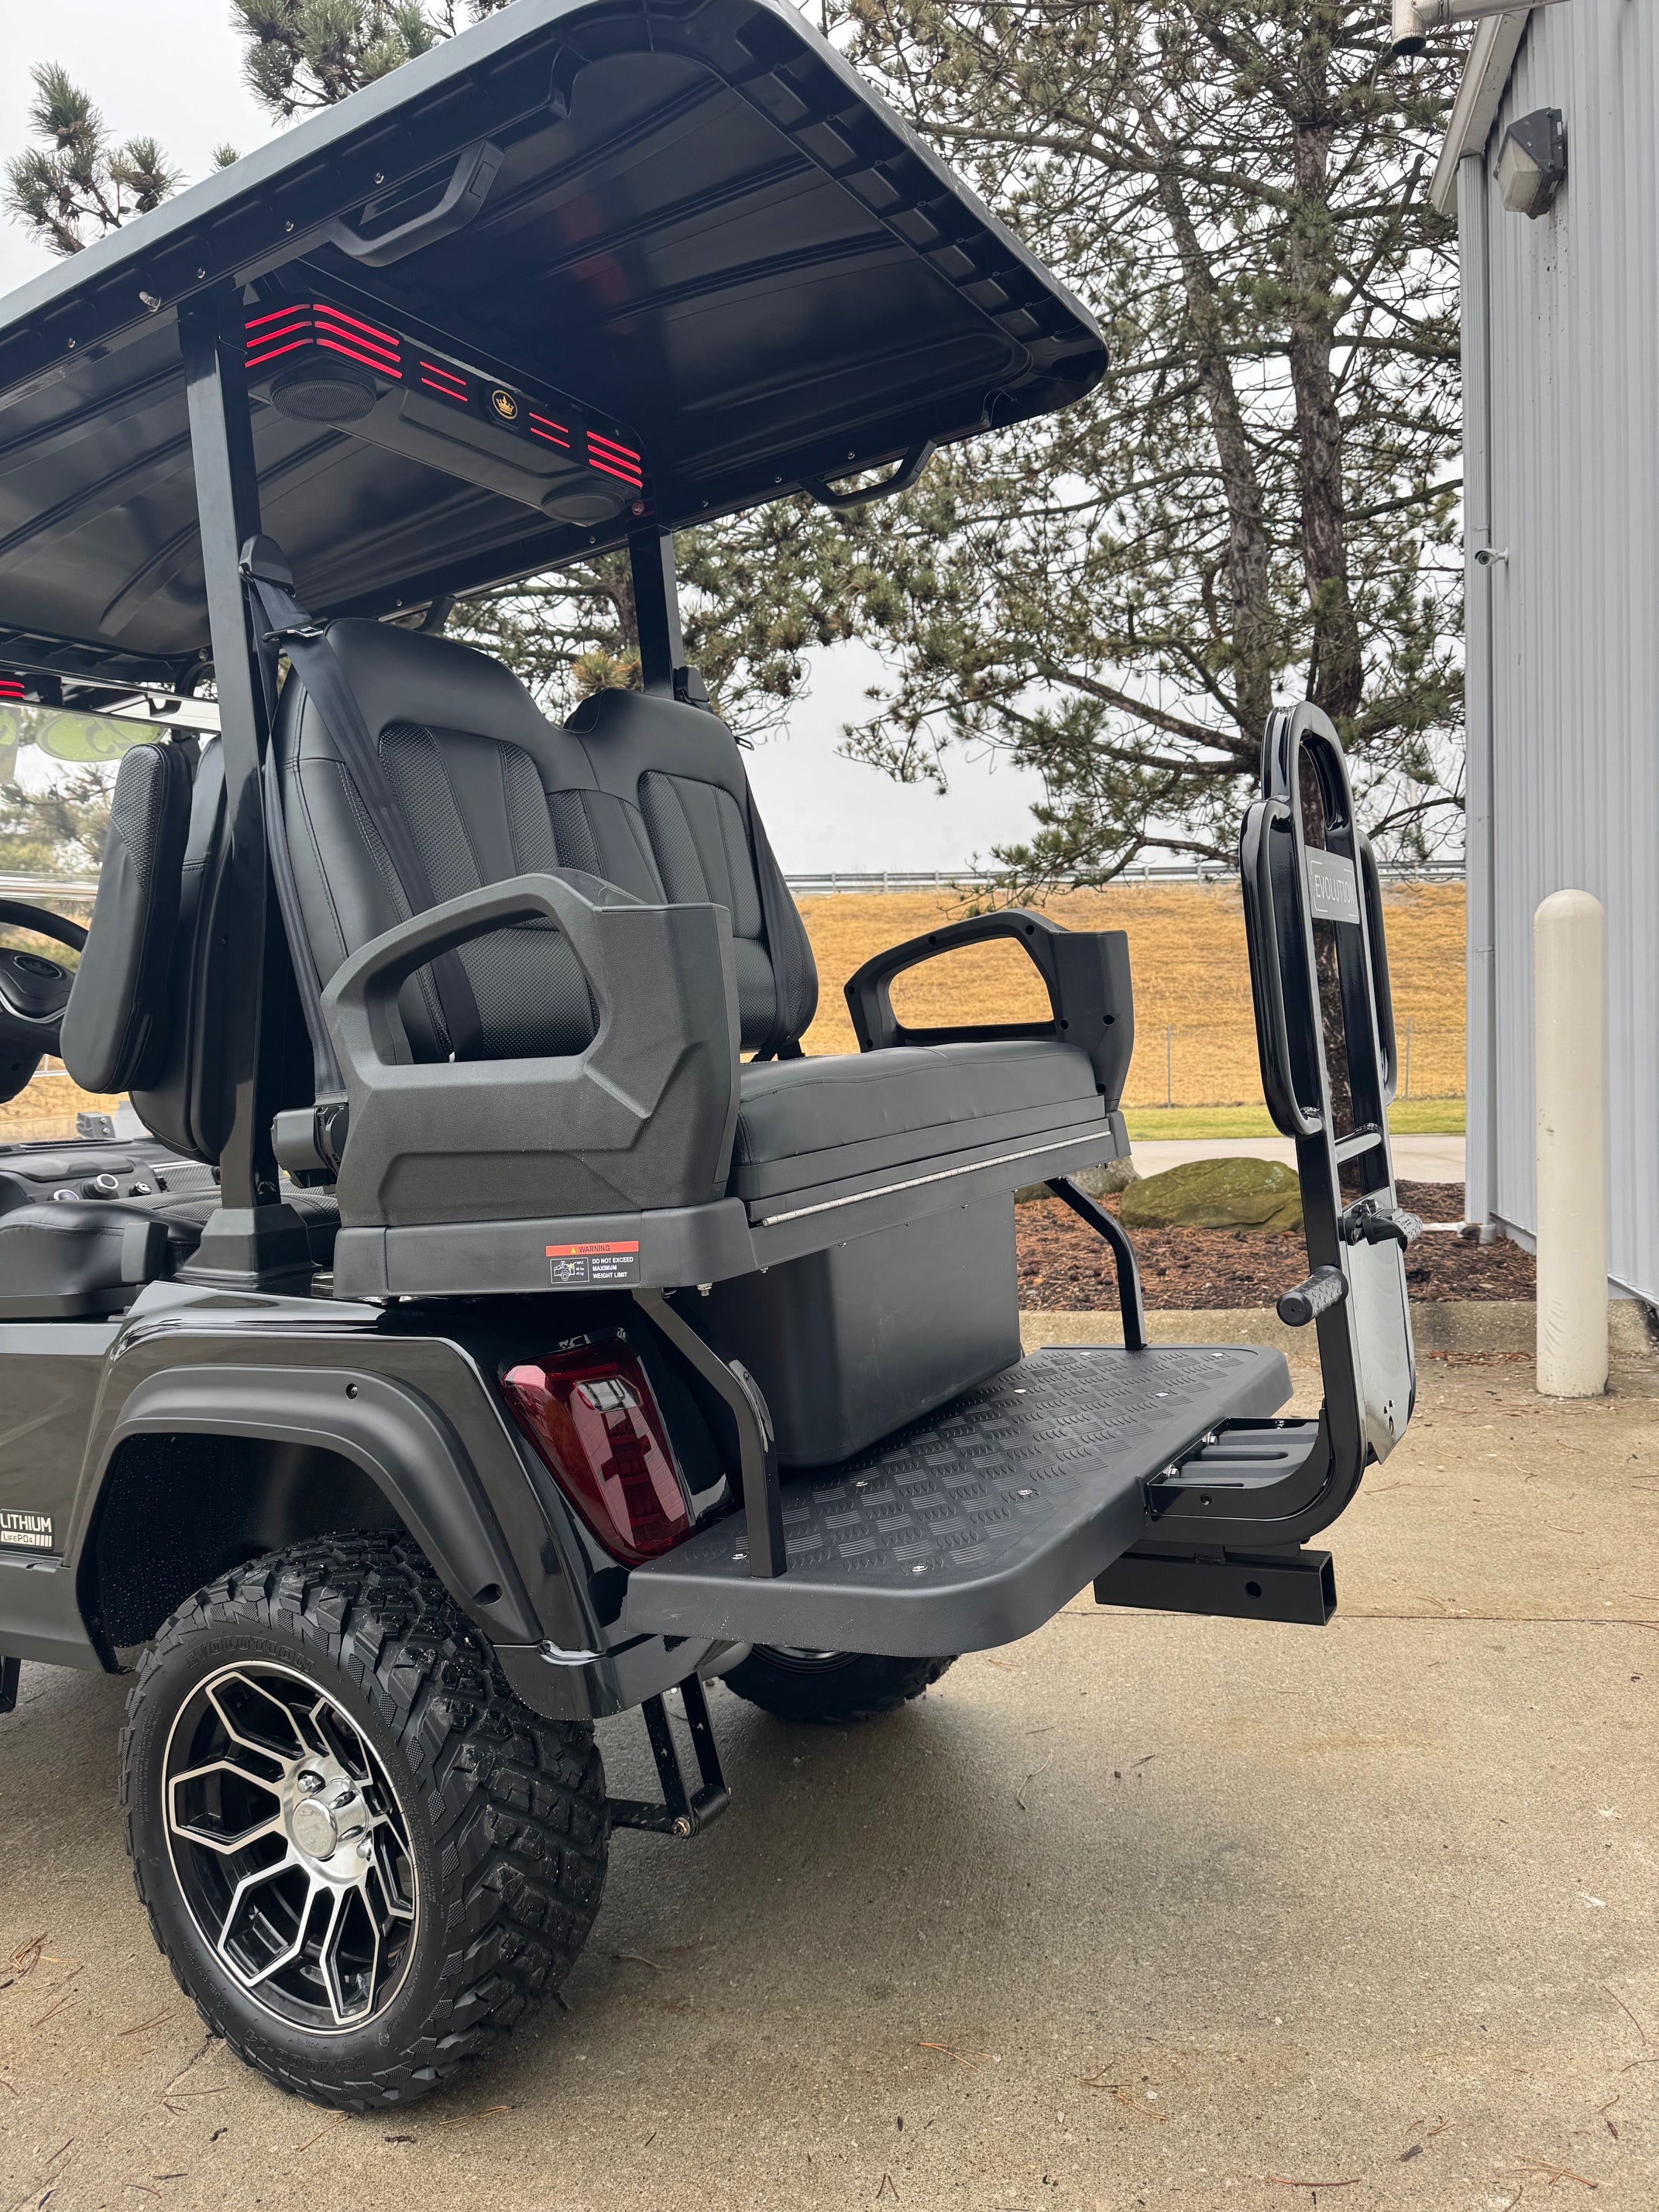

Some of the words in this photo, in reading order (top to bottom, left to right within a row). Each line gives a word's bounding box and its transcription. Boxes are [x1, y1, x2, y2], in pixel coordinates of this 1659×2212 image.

[1314, 874, 1355, 905] EVOLUTION
[579, 1245, 610, 1253] WARNING
[0, 1513, 52, 1533] LITHIUM
[184, 1634, 314, 1671] EVOLUTION
